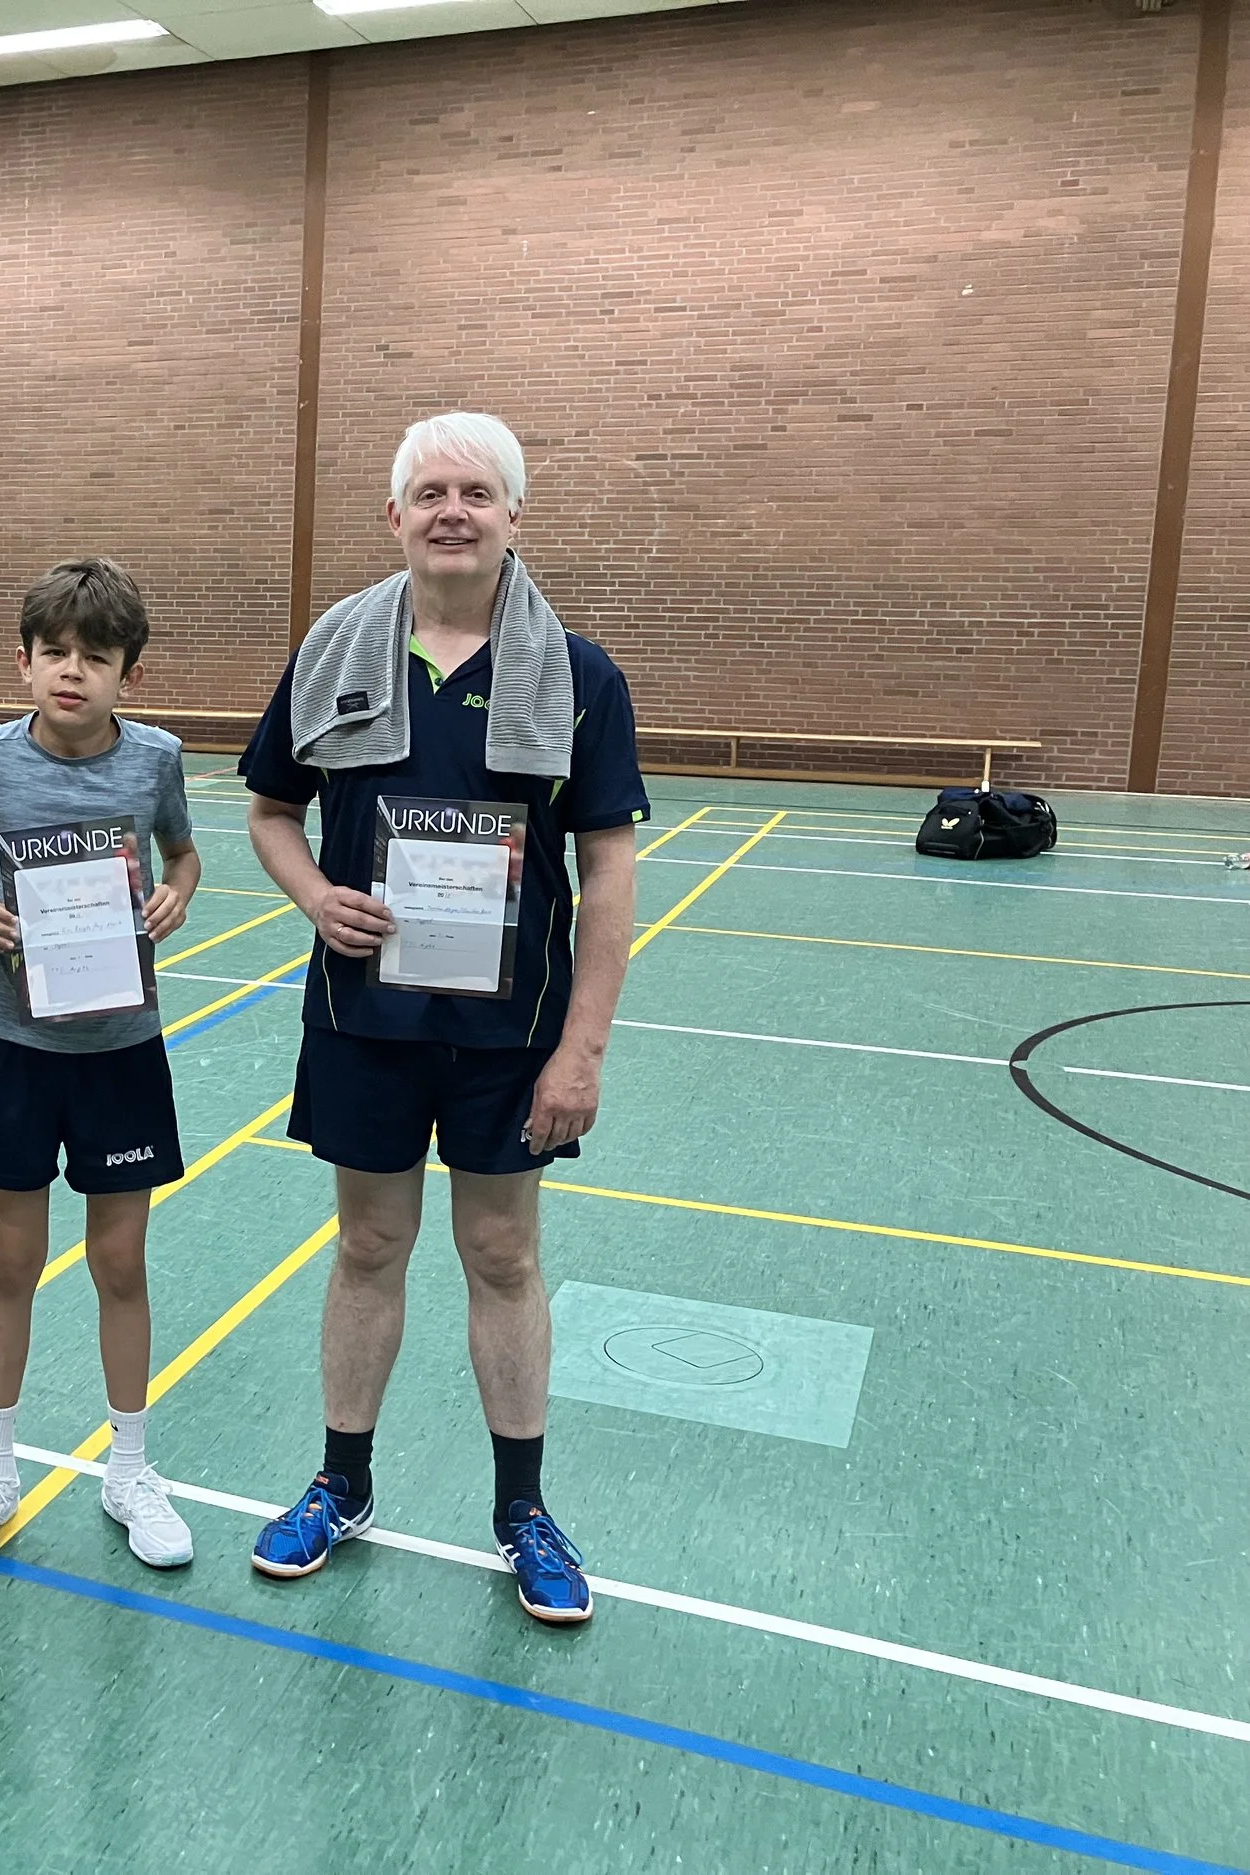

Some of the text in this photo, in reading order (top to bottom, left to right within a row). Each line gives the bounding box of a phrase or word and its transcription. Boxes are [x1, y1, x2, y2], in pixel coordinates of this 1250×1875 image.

[391, 808, 511, 837] URKUNDE
[11, 826, 124, 862] URKUNDE
[106, 1145, 155, 1167] JOOLA
